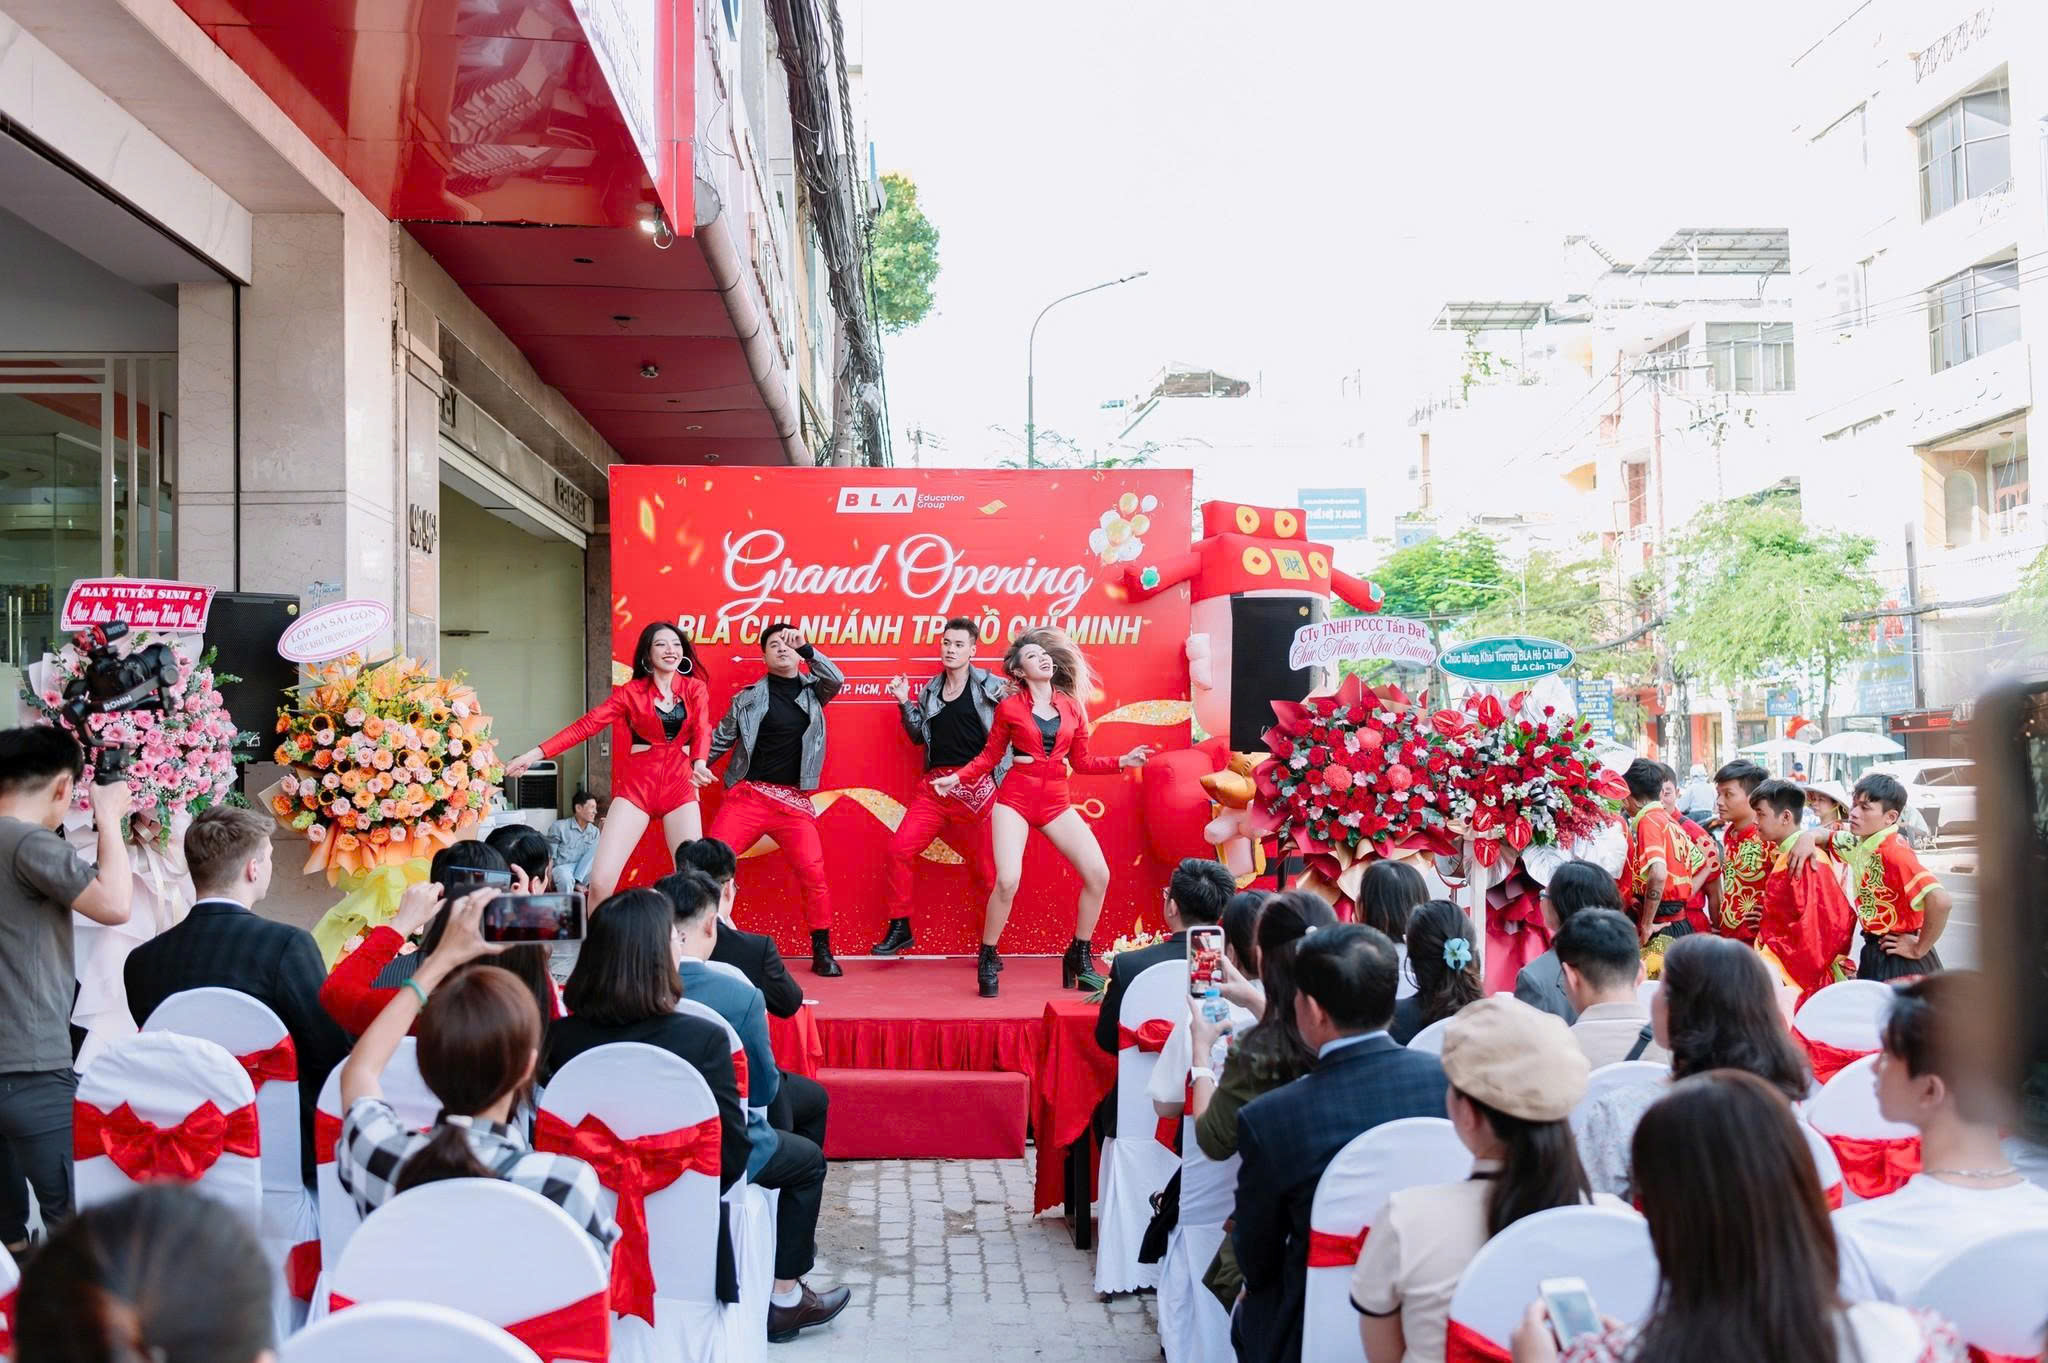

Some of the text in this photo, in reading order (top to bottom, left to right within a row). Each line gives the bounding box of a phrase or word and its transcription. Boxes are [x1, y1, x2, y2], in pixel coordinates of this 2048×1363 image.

[845, 493, 965, 507] BLA Education
[917, 501, 945, 510] Group
[717, 529, 1095, 621] Grand Opening
[80, 587, 110, 597] BAN
[157, 588, 191, 600] SINH
[193, 592, 203, 600] 2
[677, 614, 731, 645] BLA
[800, 608, 904, 645] NHÁNH
[1065, 615, 1142, 645] MINH
[1300, 628, 1319, 643] CTy
[1322, 619, 1351, 637] TNHH
[1355, 618, 1383, 632] PCCC
[1408, 622, 1426, 640] Đạt
[1361, 633, 1394, 656] Khai
[1444, 652, 1461, 665] Chúc
[1480, 650, 1495, 663] Khai
[1519, 650, 1532, 661] BLA
[1553, 647, 1570, 660] Minh
[1511, 664, 1529, 672] BLA
[1529, 661, 1545, 671] Cần
[854, 683, 881, 696] HCM,
[103, 694, 133, 712] RONIN
